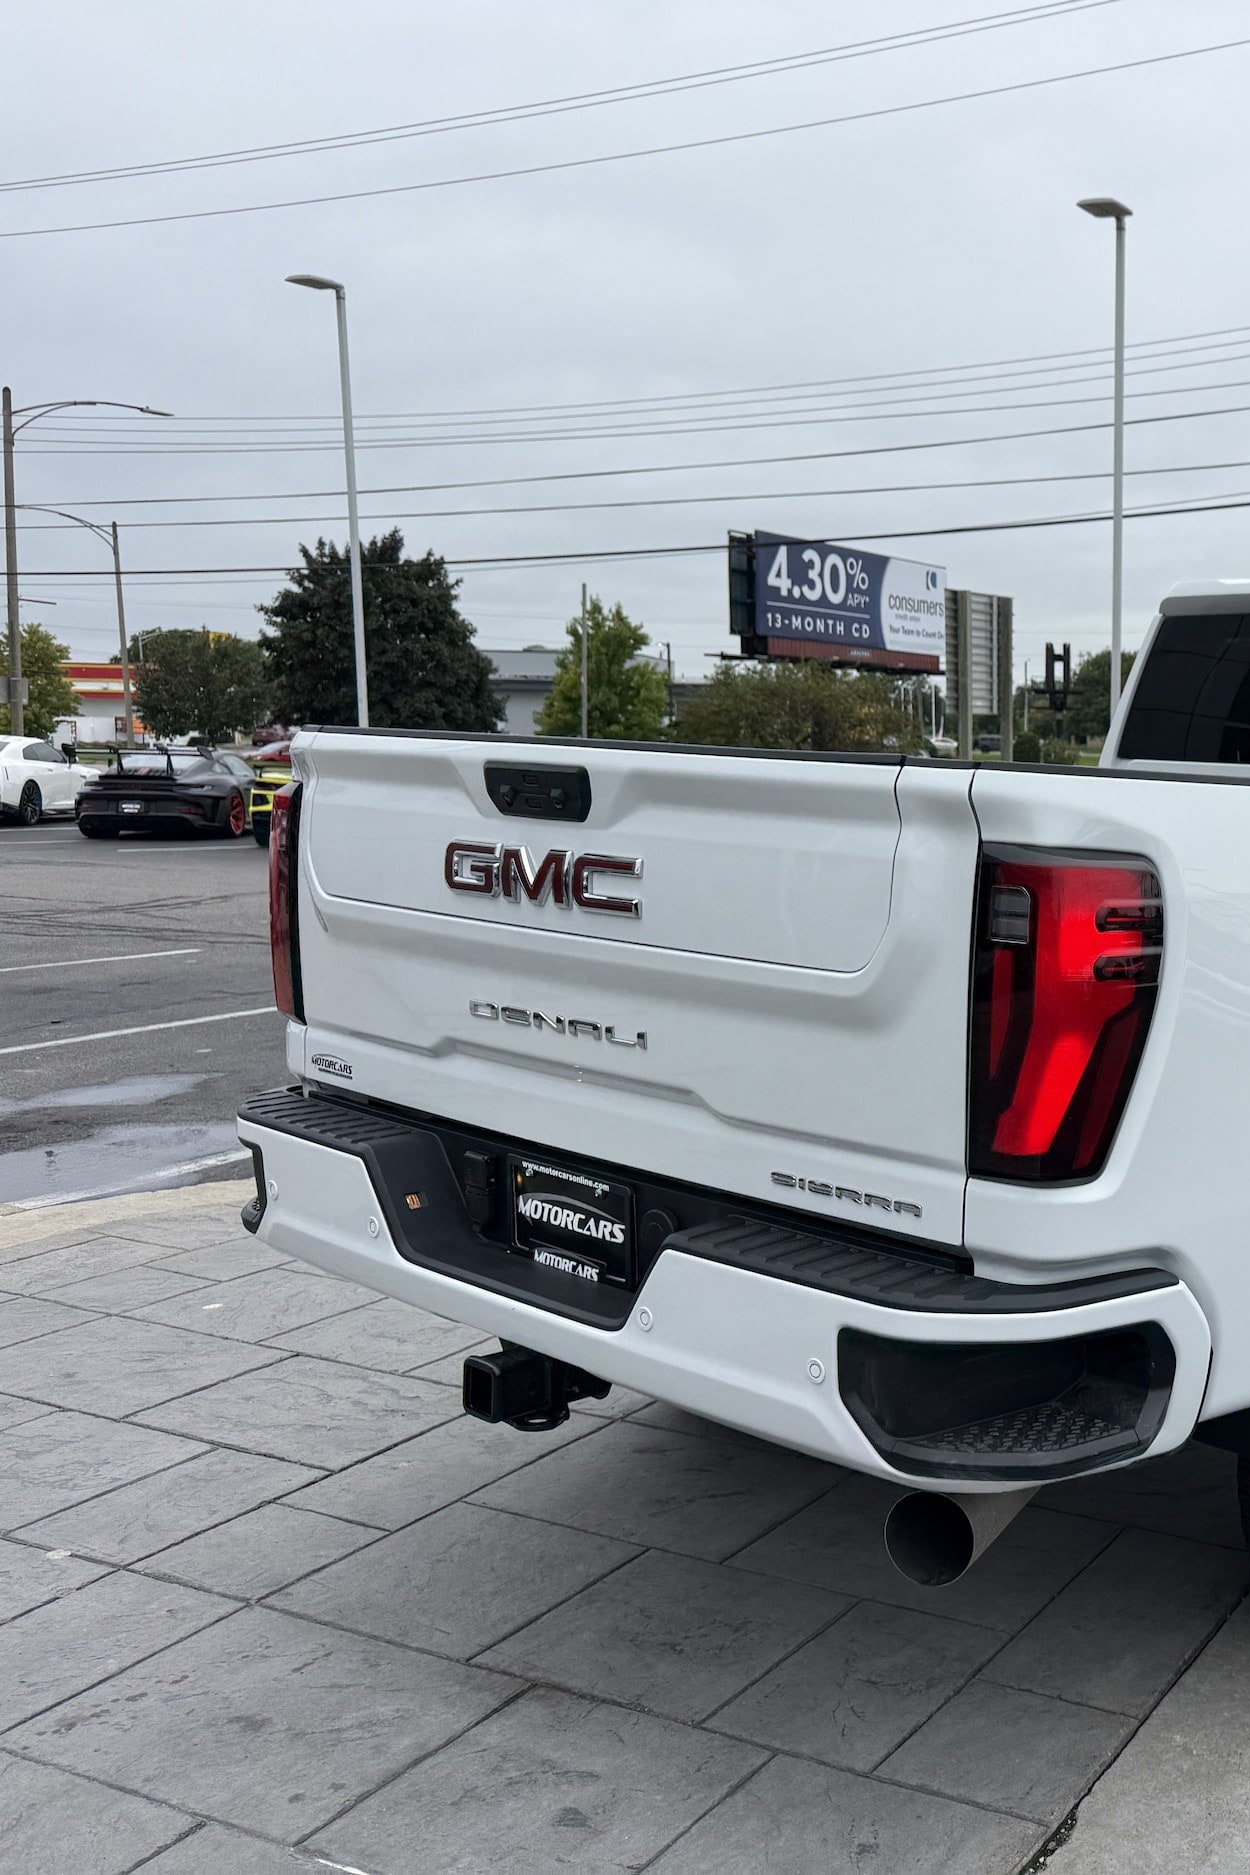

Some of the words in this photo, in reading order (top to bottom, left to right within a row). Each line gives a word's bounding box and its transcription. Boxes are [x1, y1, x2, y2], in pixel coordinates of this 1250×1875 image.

[767, 545, 869, 605] 4.30%
[888, 594, 944, 618] consumers
[766, 612, 845, 636] 13-MONTH
[852, 622, 870, 638] CD
[888, 624, 901, 634] Your
[901, 625, 915, 636] Team
[922, 628, 937, 638] Count
[444, 839, 644, 919] GMC
[469, 1000, 648, 1050] DENALI
[311, 1055, 353, 1075] MOTORCARS
[521, 1160, 610, 1192] www.motorcarsonline.com
[770, 1172, 923, 1218] SIERRA
[518, 1195, 626, 1244] MOTORCARS
[533, 1249, 600, 1282] MOTORCARS
